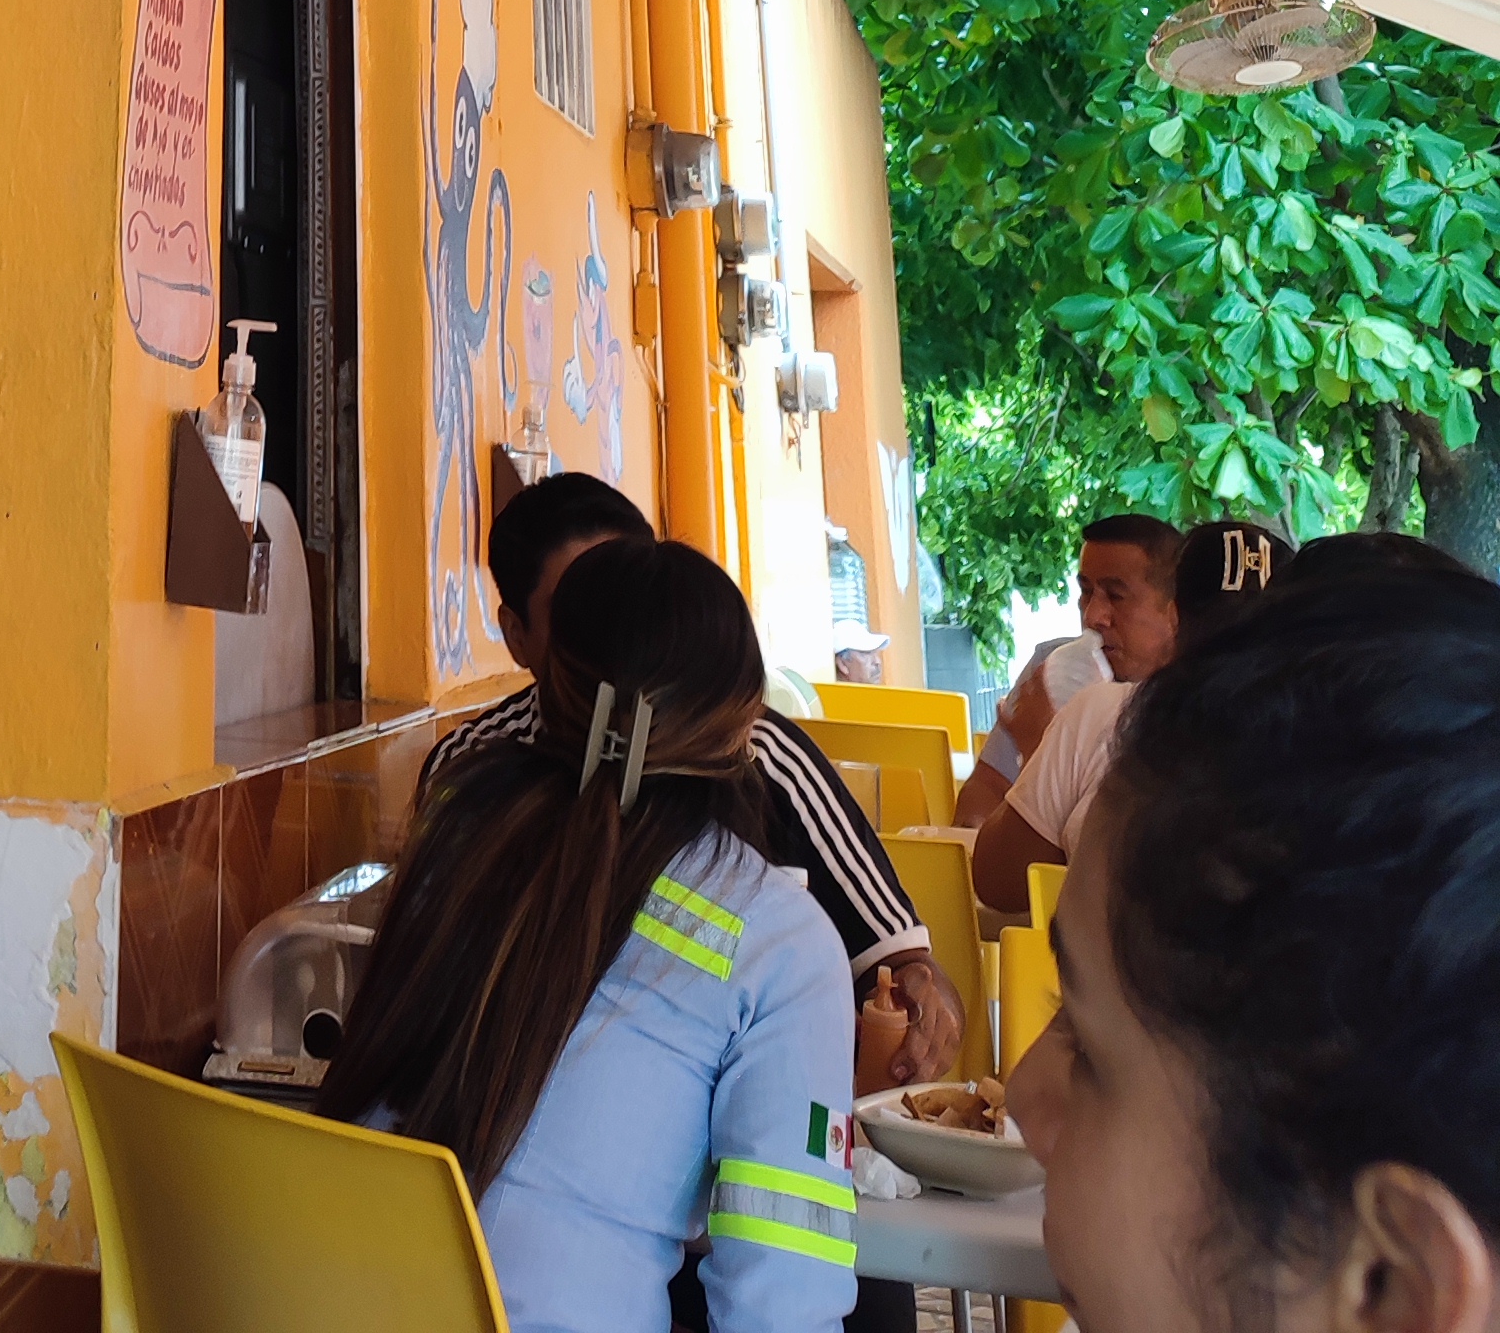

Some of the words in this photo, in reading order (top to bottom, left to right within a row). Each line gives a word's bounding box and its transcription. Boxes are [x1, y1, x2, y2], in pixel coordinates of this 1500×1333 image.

[144, 20, 182, 73] Caldos
[167, 81, 181, 117] al
[180, 93, 204, 134] mojo
[136, 105, 149, 151] de
[173, 129, 181, 175] y
